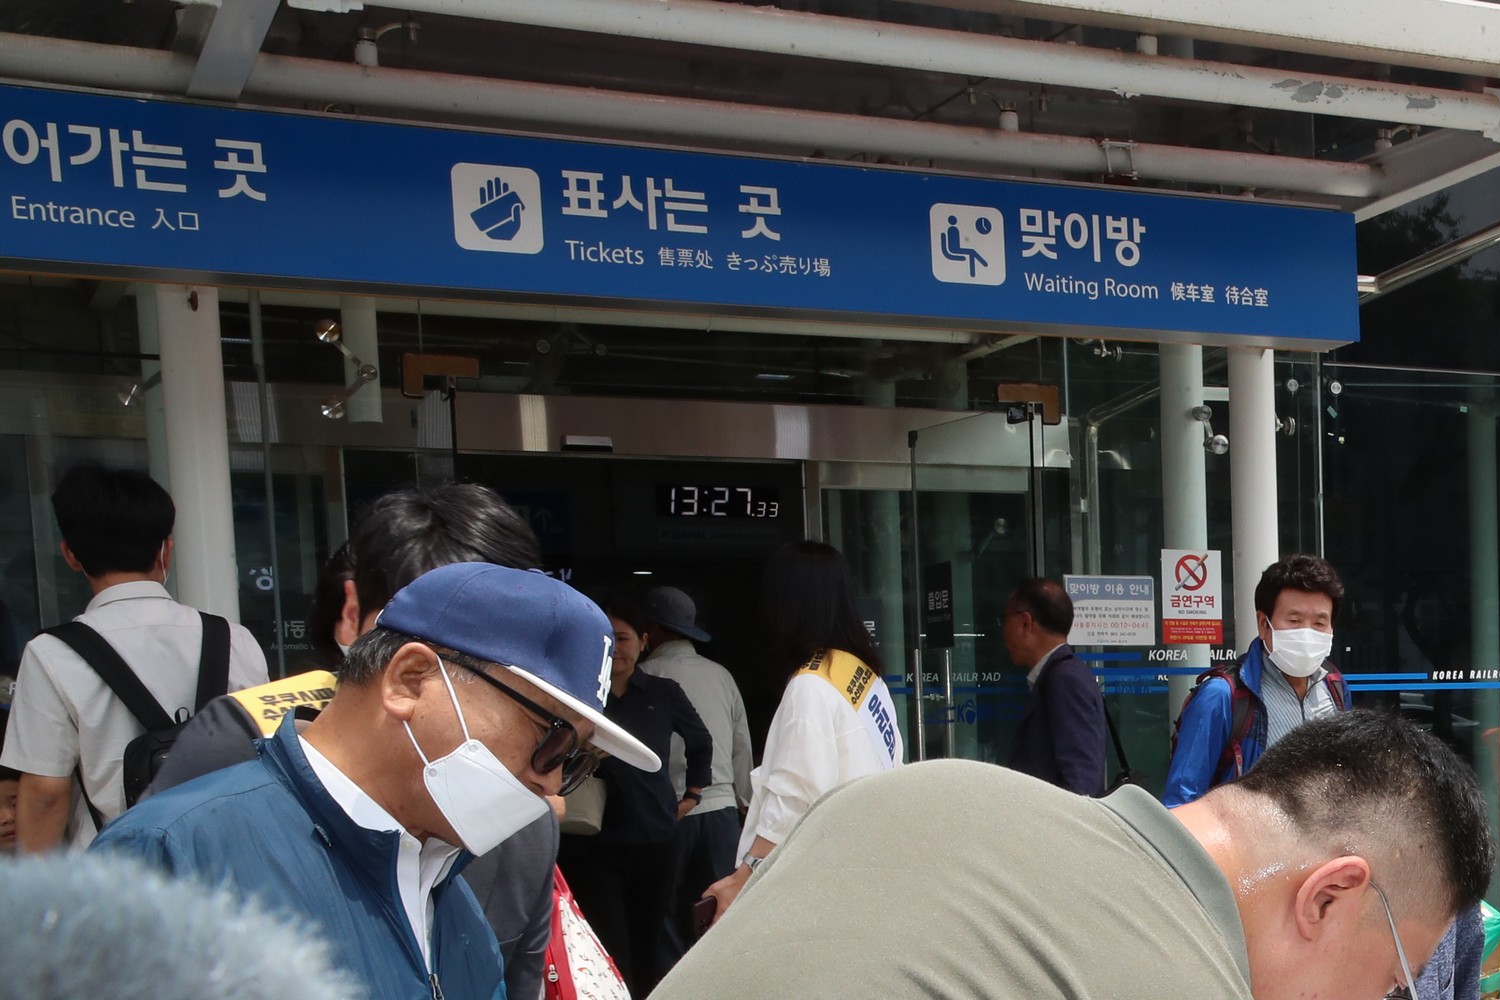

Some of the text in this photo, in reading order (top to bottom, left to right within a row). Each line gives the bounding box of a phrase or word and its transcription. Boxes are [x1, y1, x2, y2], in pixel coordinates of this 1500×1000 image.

[2, 118, 267, 202] 어가는 곳
[12, 196, 200, 232] Entrance 入口
[561, 170, 781, 241] 표사는 곳
[1020, 208, 1146, 267] 맞이방
[565, 240, 831, 278] Tickets 售票处 きっぷ売り場
[1025, 273, 1269, 308] Waiting Room 候车室 待合室
[1069, 582, 1149, 596] 맞이방 이용 안내
[1170, 595, 1215, 609] 금연구역
[1148, 649, 1188, 661] KOREA
[906, 672, 939, 682] KREA
[1432, 670, 1464, 680] KOREA
